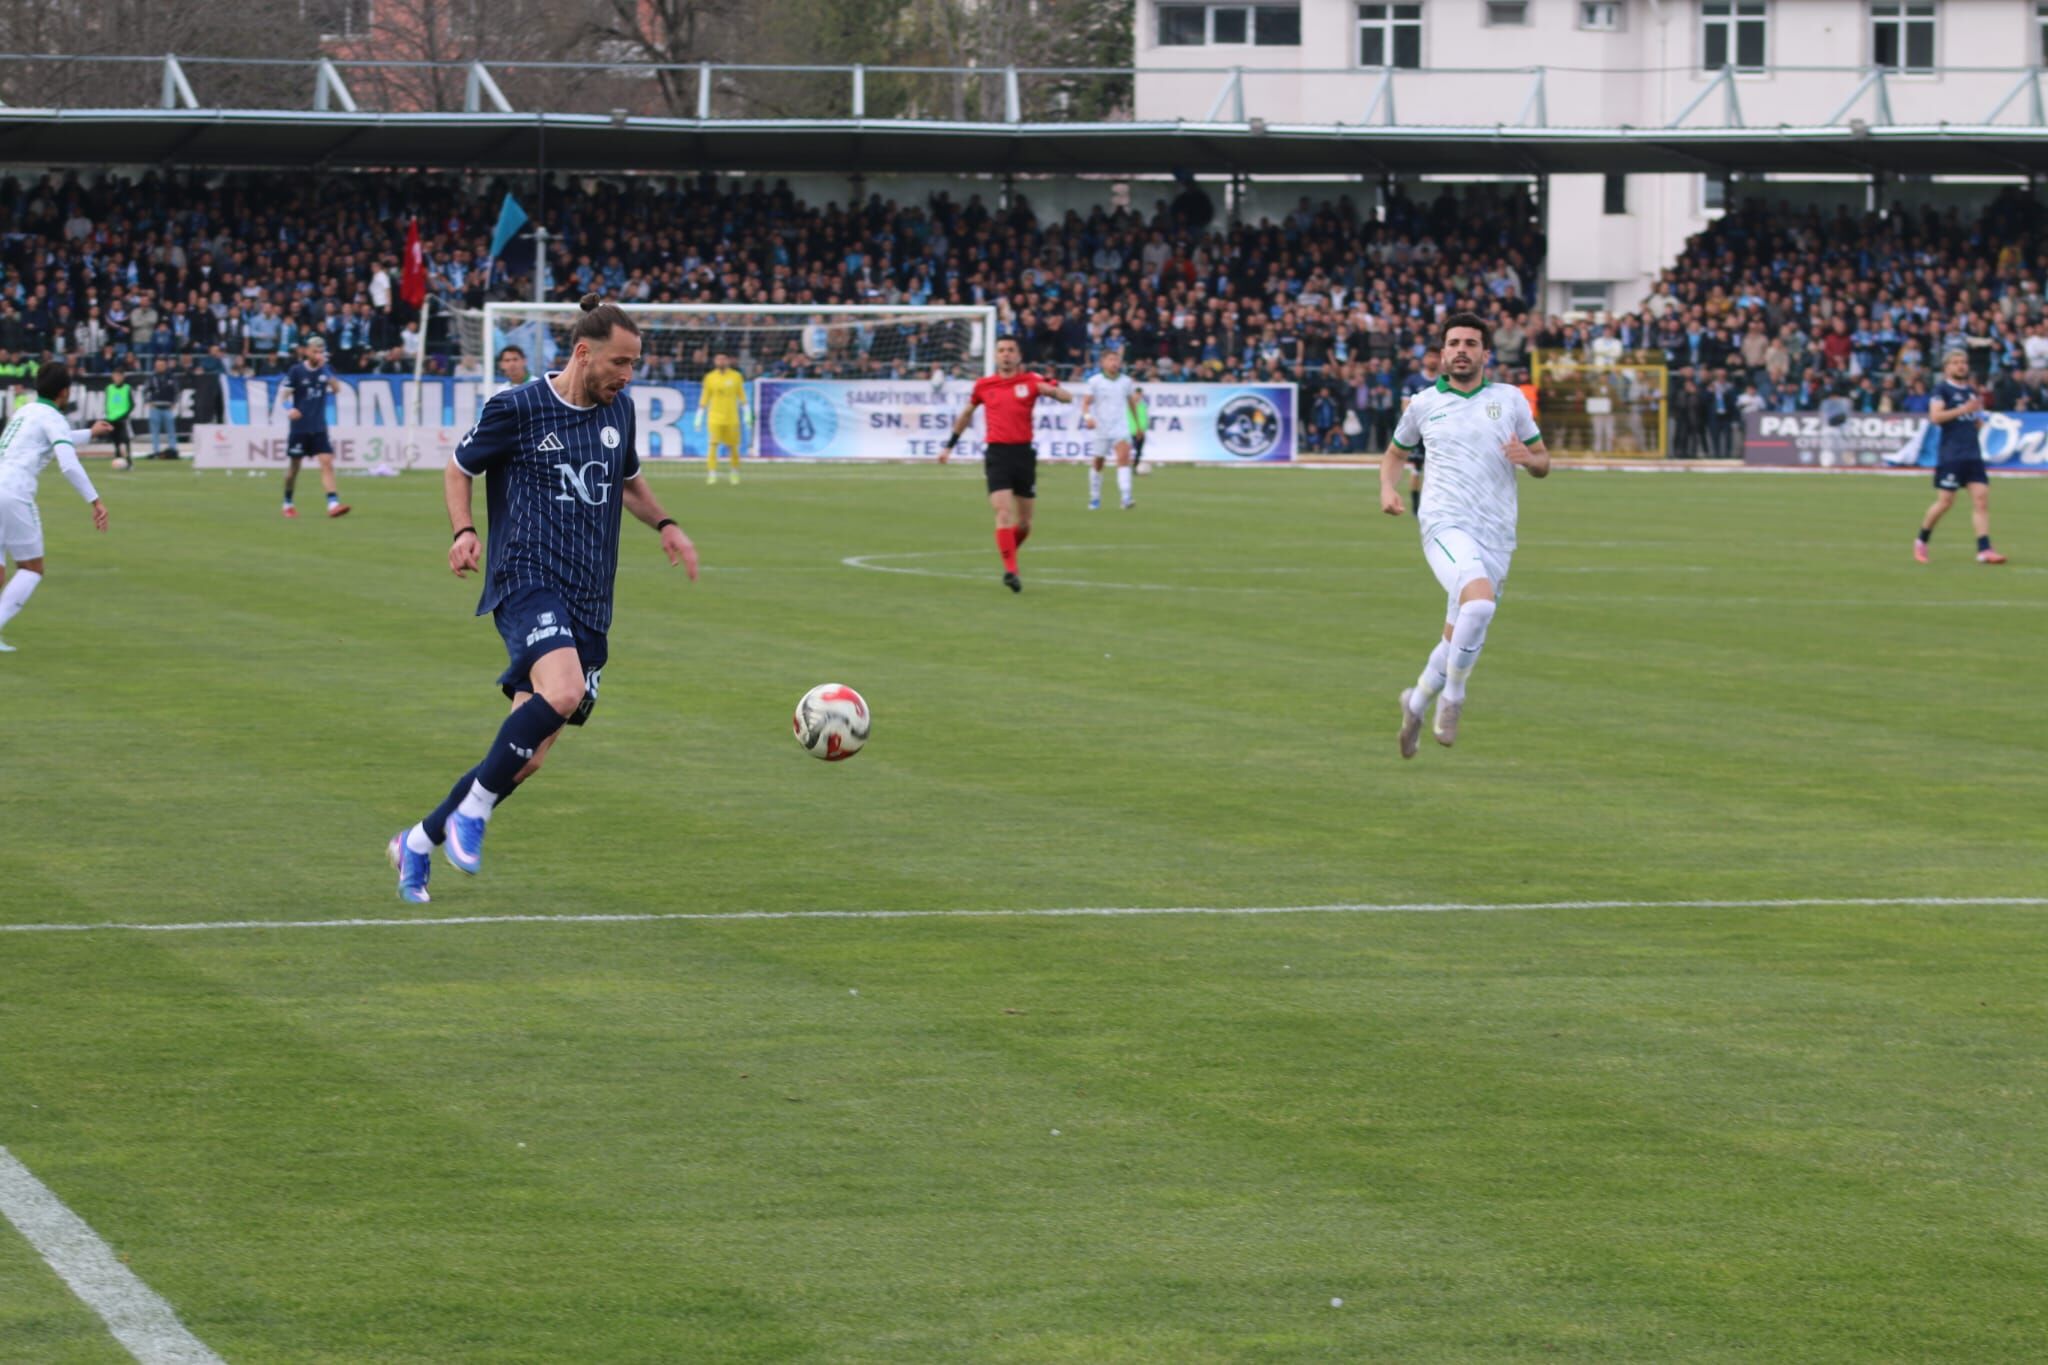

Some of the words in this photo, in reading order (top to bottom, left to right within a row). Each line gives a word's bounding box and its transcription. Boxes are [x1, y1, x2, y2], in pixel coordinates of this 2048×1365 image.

[1156, 393, 1207, 407] DOLAYI
[870, 412, 909, 429] SN.
[919, 410, 974, 429] ESİ
[553, 460, 612, 506] NG
